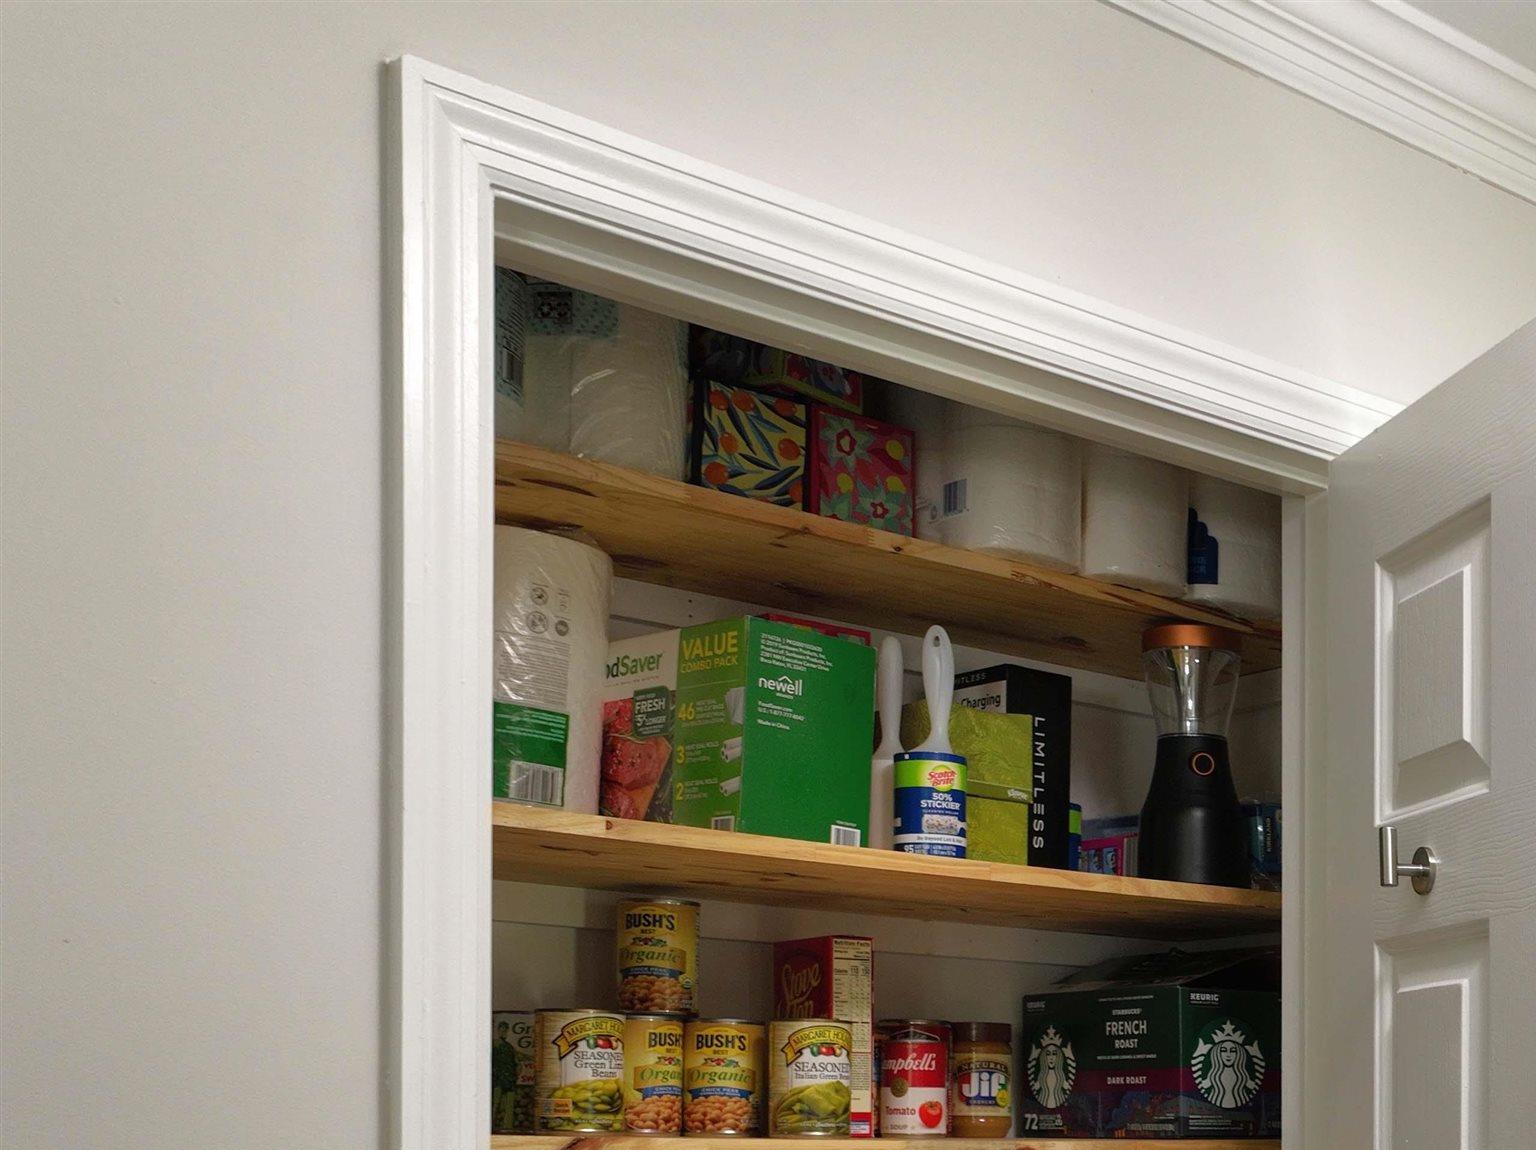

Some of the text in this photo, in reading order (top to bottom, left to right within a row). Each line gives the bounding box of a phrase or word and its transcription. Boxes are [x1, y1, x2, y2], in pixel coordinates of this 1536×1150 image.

[682, 630, 738, 659] VALUE
[606, 653, 663, 679] dSaver
[681, 654, 738, 673] COMBO PACK
[758, 676, 803, 697] newell
[635, 697, 666, 715] FRESH
[960, 692, 1001, 710] Charging
[677, 702, 695, 721] 46
[676, 746, 685, 764] 3
[928, 769, 957, 781] Scotch
[1032, 716, 1047, 849] LIMITLESS
[675, 782, 685, 801] 2
[932, 791, 954, 802] 50%
[920, 799, 961, 811] STICKIER
[625, 912, 676, 931] BUSH'S
[620, 947, 680, 964] Organic
[1189, 991, 1220, 1003] KEURIG
[566, 1021, 608, 1036] MARGARET
[792, 1029, 831, 1044] MARGARET
[1105, 1019, 1148, 1036] FRENCH
[648, 1031, 682, 1049] BUSH
[696, 1033, 747, 1052] BUSH'S
[1114, 1038, 1139, 1049] ROAST
[574, 1050, 623, 1061] SEASONE
[883, 1052, 937, 1074] mpbell's
[574, 1060, 606, 1070] Green
[961, 1060, 1008, 1072] NATURAL
[688, 1067, 752, 1084] Organic
[961, 1071, 1006, 1098] Jif
[1106, 1075, 1148, 1085] DARK ROAST
[886, 1105, 916, 1116] Tomato
[1024, 1113, 1039, 1131] 72
